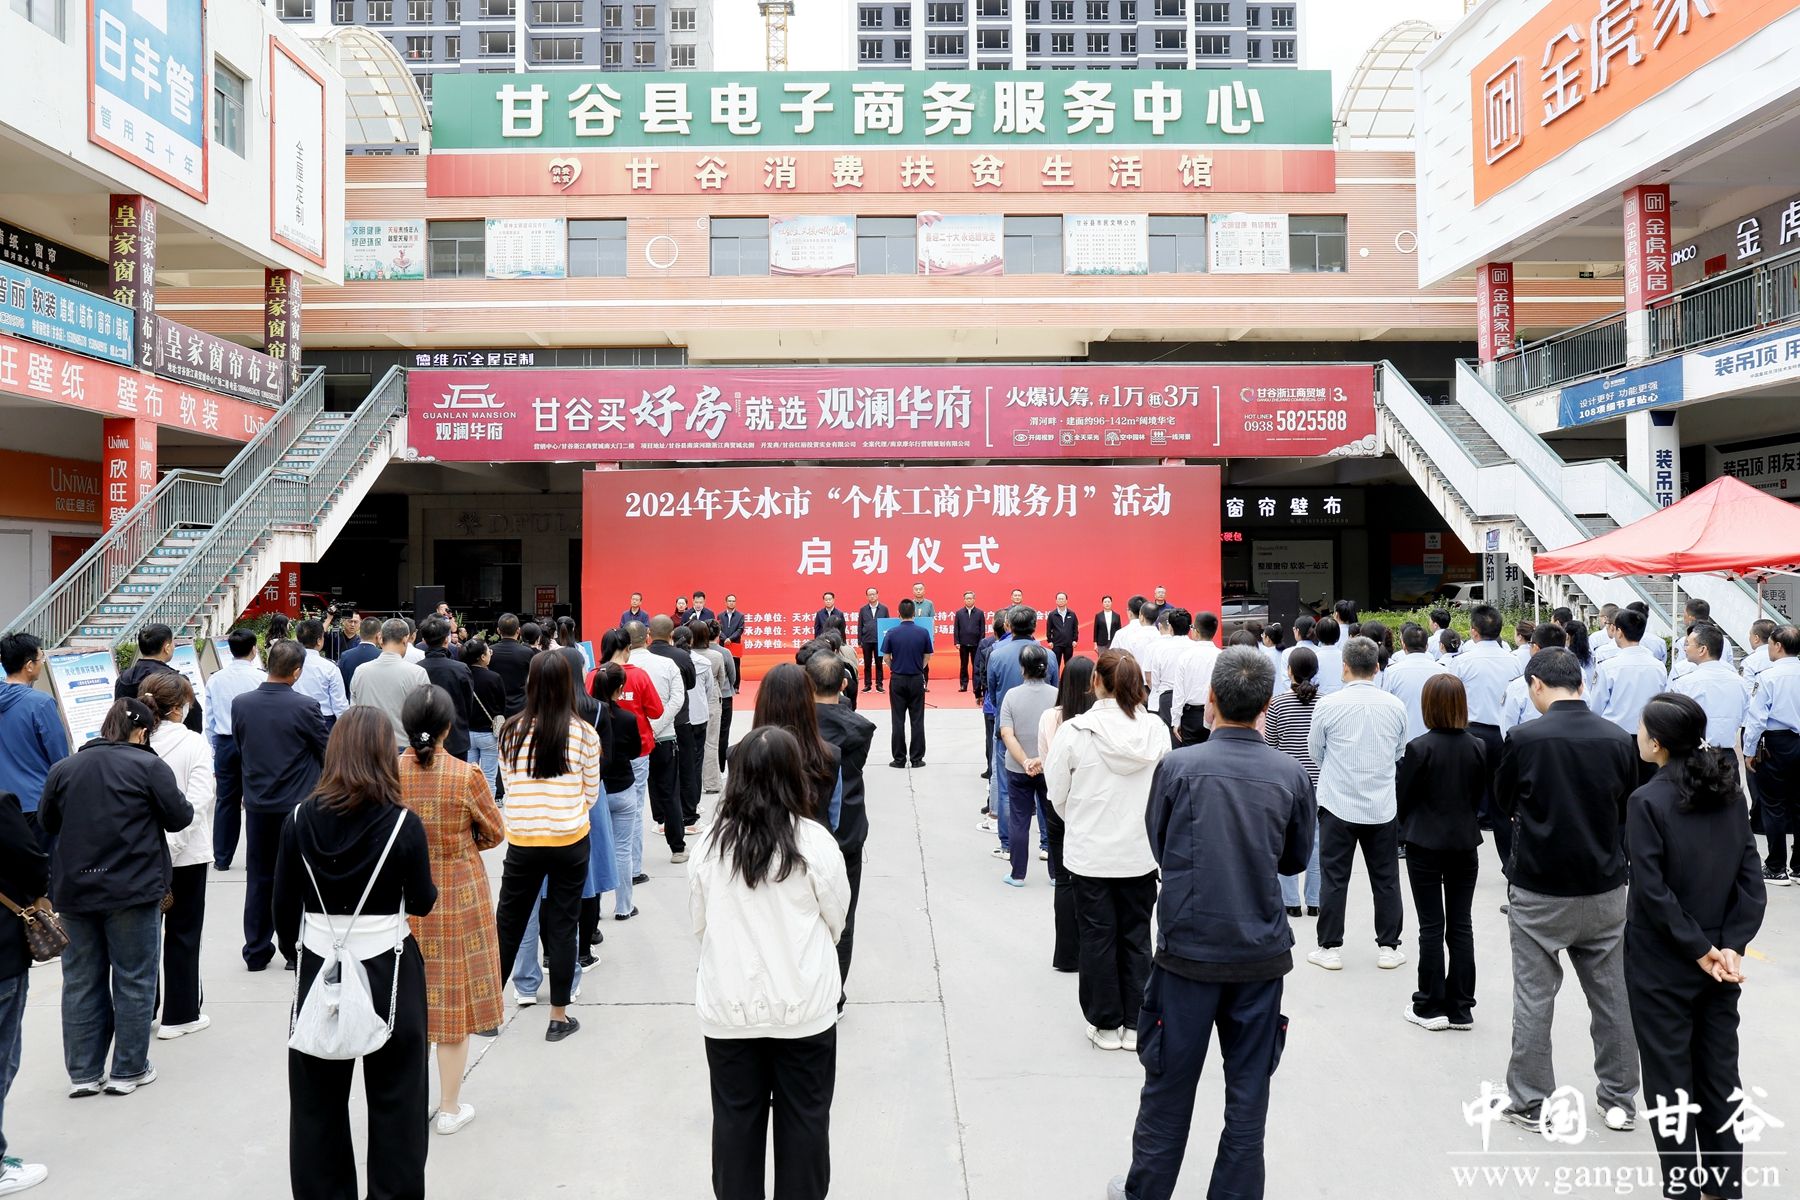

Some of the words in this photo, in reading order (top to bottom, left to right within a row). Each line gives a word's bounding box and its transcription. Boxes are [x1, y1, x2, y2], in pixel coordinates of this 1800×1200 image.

[100, 9, 194, 126] 日丰管
[496, 81, 1265, 138] 甘谷县电子商务服务中心
[100, 105, 194, 176] 管用五十年
[625, 154, 1214, 190] 甘谷消费扶贫生活馆
[352, 226, 382, 235] 文明健康
[352, 238, 382, 246] 绿色环保
[112, 205, 137, 306] 皇家窗帘
[1646, 218, 1668, 291] 金虎家居
[32, 287, 57, 318] 软装
[142, 210, 155, 367] 皇家窗帘布艺
[268, 275, 286, 359] 皇家窗帘
[1493, 288, 1510, 347] 金虎家居
[165, 327, 280, 388] 皇家窗帘布艺
[415, 352, 534, 367] 德维尔全屋定制
[1714, 344, 1778, 377] 装吊顶
[117, 375, 163, 418] 壁布
[180, 392, 219, 431] 软装
[1257, 388, 1326, 398] 甘谷浙江商贸城
[1579, 391, 1614, 408] 设计更好
[1618, 381, 1658, 397] 功能更强
[1579, 393, 1658, 418] 108项细节更贴心
[423, 411, 468, 419] GUANLAN
[472, 411, 517, 419] MANSION
[531, 397, 626, 432] 甘谷买
[629, 384, 732, 440] 好房
[745, 395, 807, 431] 就选
[817, 385, 972, 430] 观澜华府
[1244, 420, 1274, 431] 0938
[1276, 409, 1347, 431] 5825588
[435, 422, 504, 441] 观澜华府
[1656, 450, 1673, 507] 装吊顶
[1723, 454, 1763, 478] 装吊顶
[1767, 447, 1800, 475] 用友
[51, 466, 100, 496] UNIWAL
[1226, 496, 1341, 518] 窗帘壁布
[797, 535, 1000, 576] 启动仪式
[1290, 561, 1329, 570] 软装一站式
